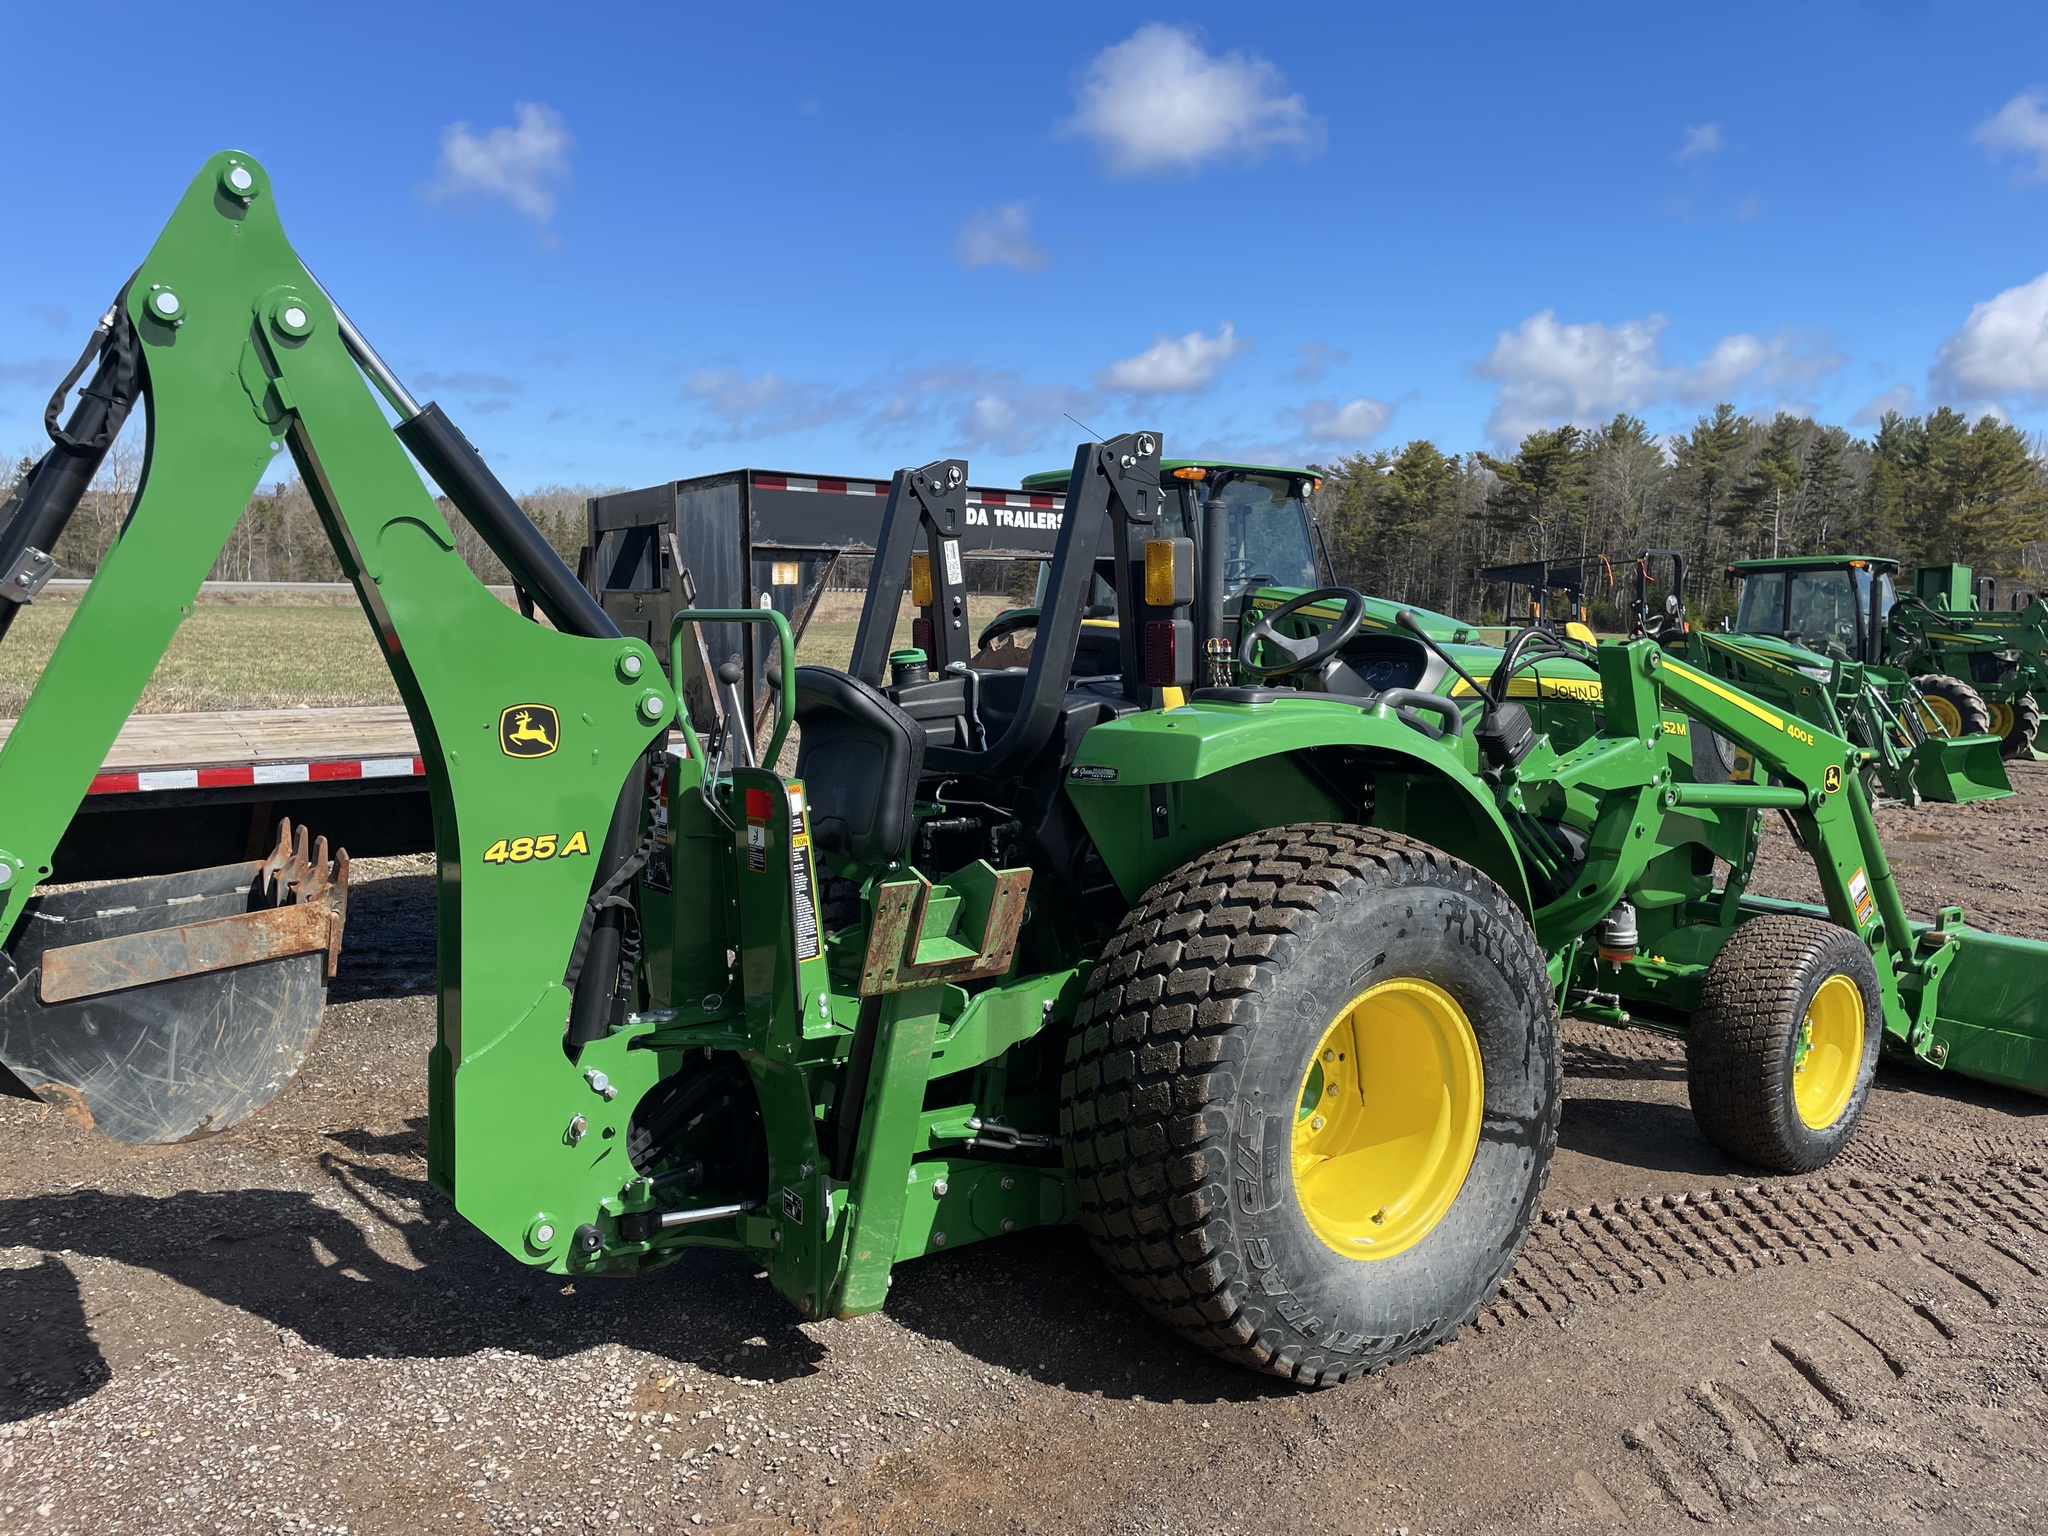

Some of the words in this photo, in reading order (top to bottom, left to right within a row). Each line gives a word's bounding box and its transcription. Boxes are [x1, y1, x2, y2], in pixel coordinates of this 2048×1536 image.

[1551, 682, 1588, 699] JOHN
[483, 833, 559, 865] 485
[559, 831, 590, 858] A
